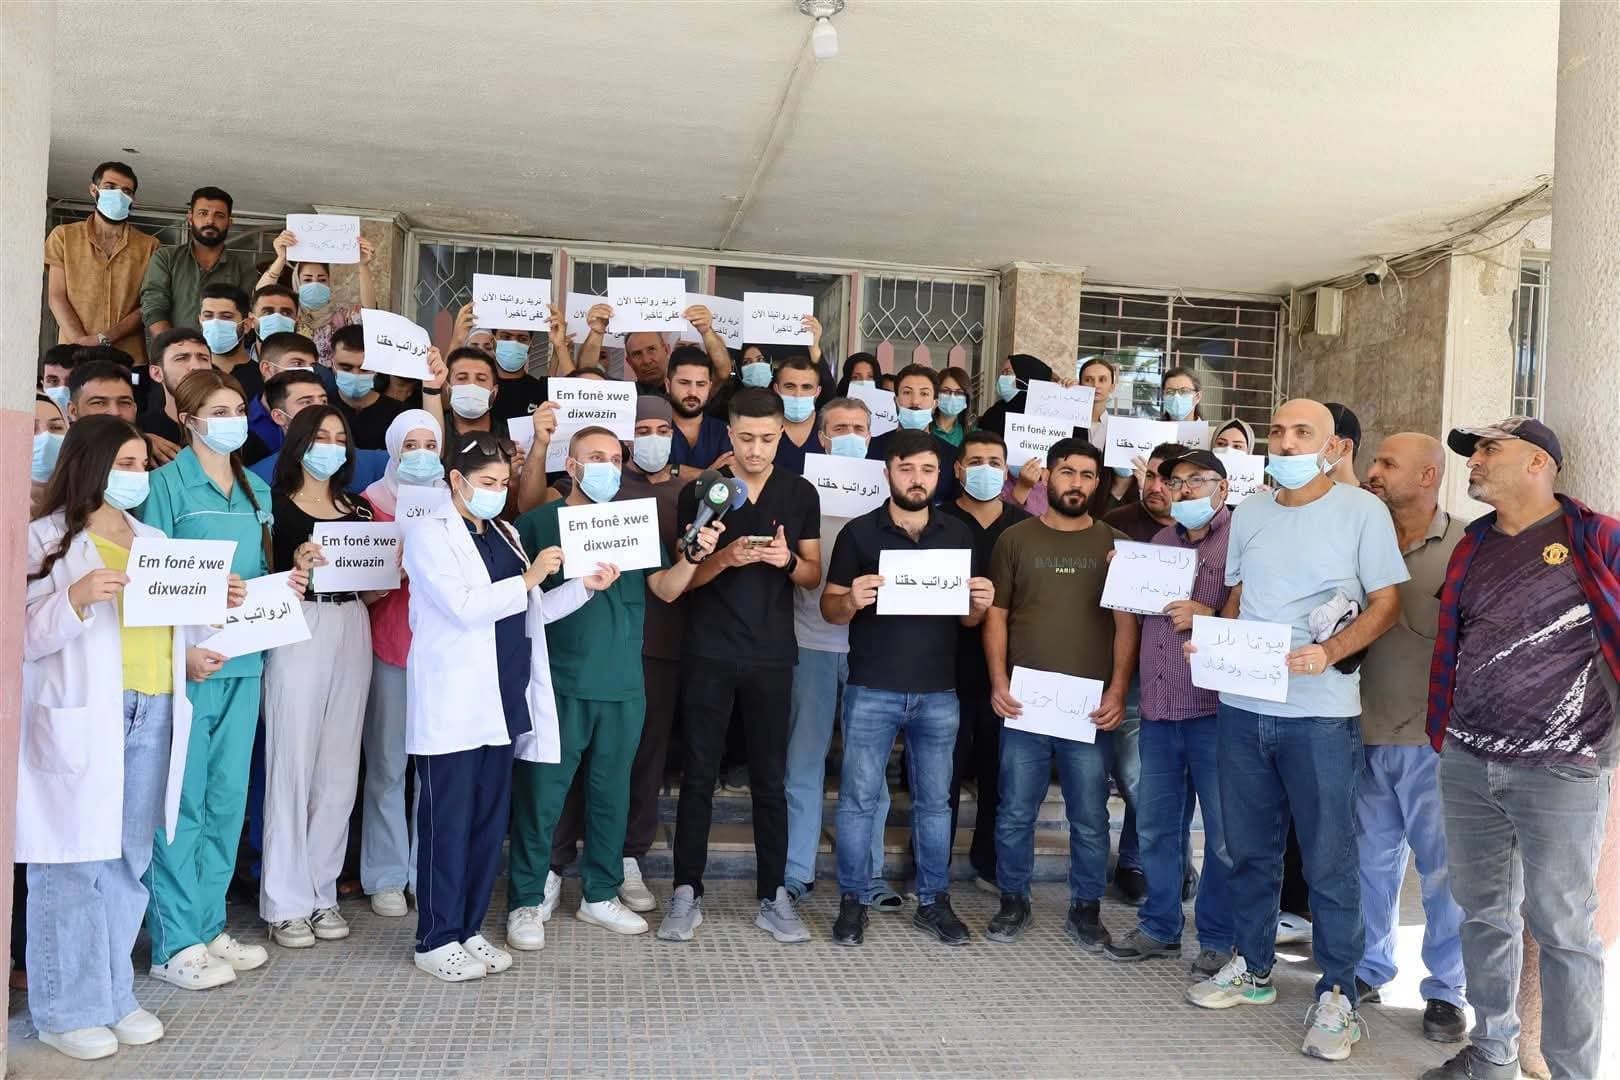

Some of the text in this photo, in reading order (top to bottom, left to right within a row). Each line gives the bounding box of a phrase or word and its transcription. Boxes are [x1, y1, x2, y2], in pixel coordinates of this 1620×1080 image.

[376, 334, 394, 347] حقنا
[556, 390, 575, 400] Em
[606, 392, 630, 402] xwe
[567, 408, 617, 420] dixwazin
[1011, 422, 1025, 433] Em
[1048, 427, 1067, 438] xwe
[1116, 438, 1135, 449] حقنا
[817, 477, 880, 497] الرواتب حقنا
[568, 514, 649, 532] Em fonê xwe
[321, 534, 397, 547] Em fonê xwe
[583, 536, 639, 552] dixwazin
[138, 554, 225, 570] Em fonê xwe
[335, 556, 385, 568] dixwazin
[1055, 567, 1076, 575] PARIS
[148, 580, 208, 596] dixwazin
[895, 574, 962, 590] الرواتب حقنا
[243, 601, 291, 624] الرواتب
